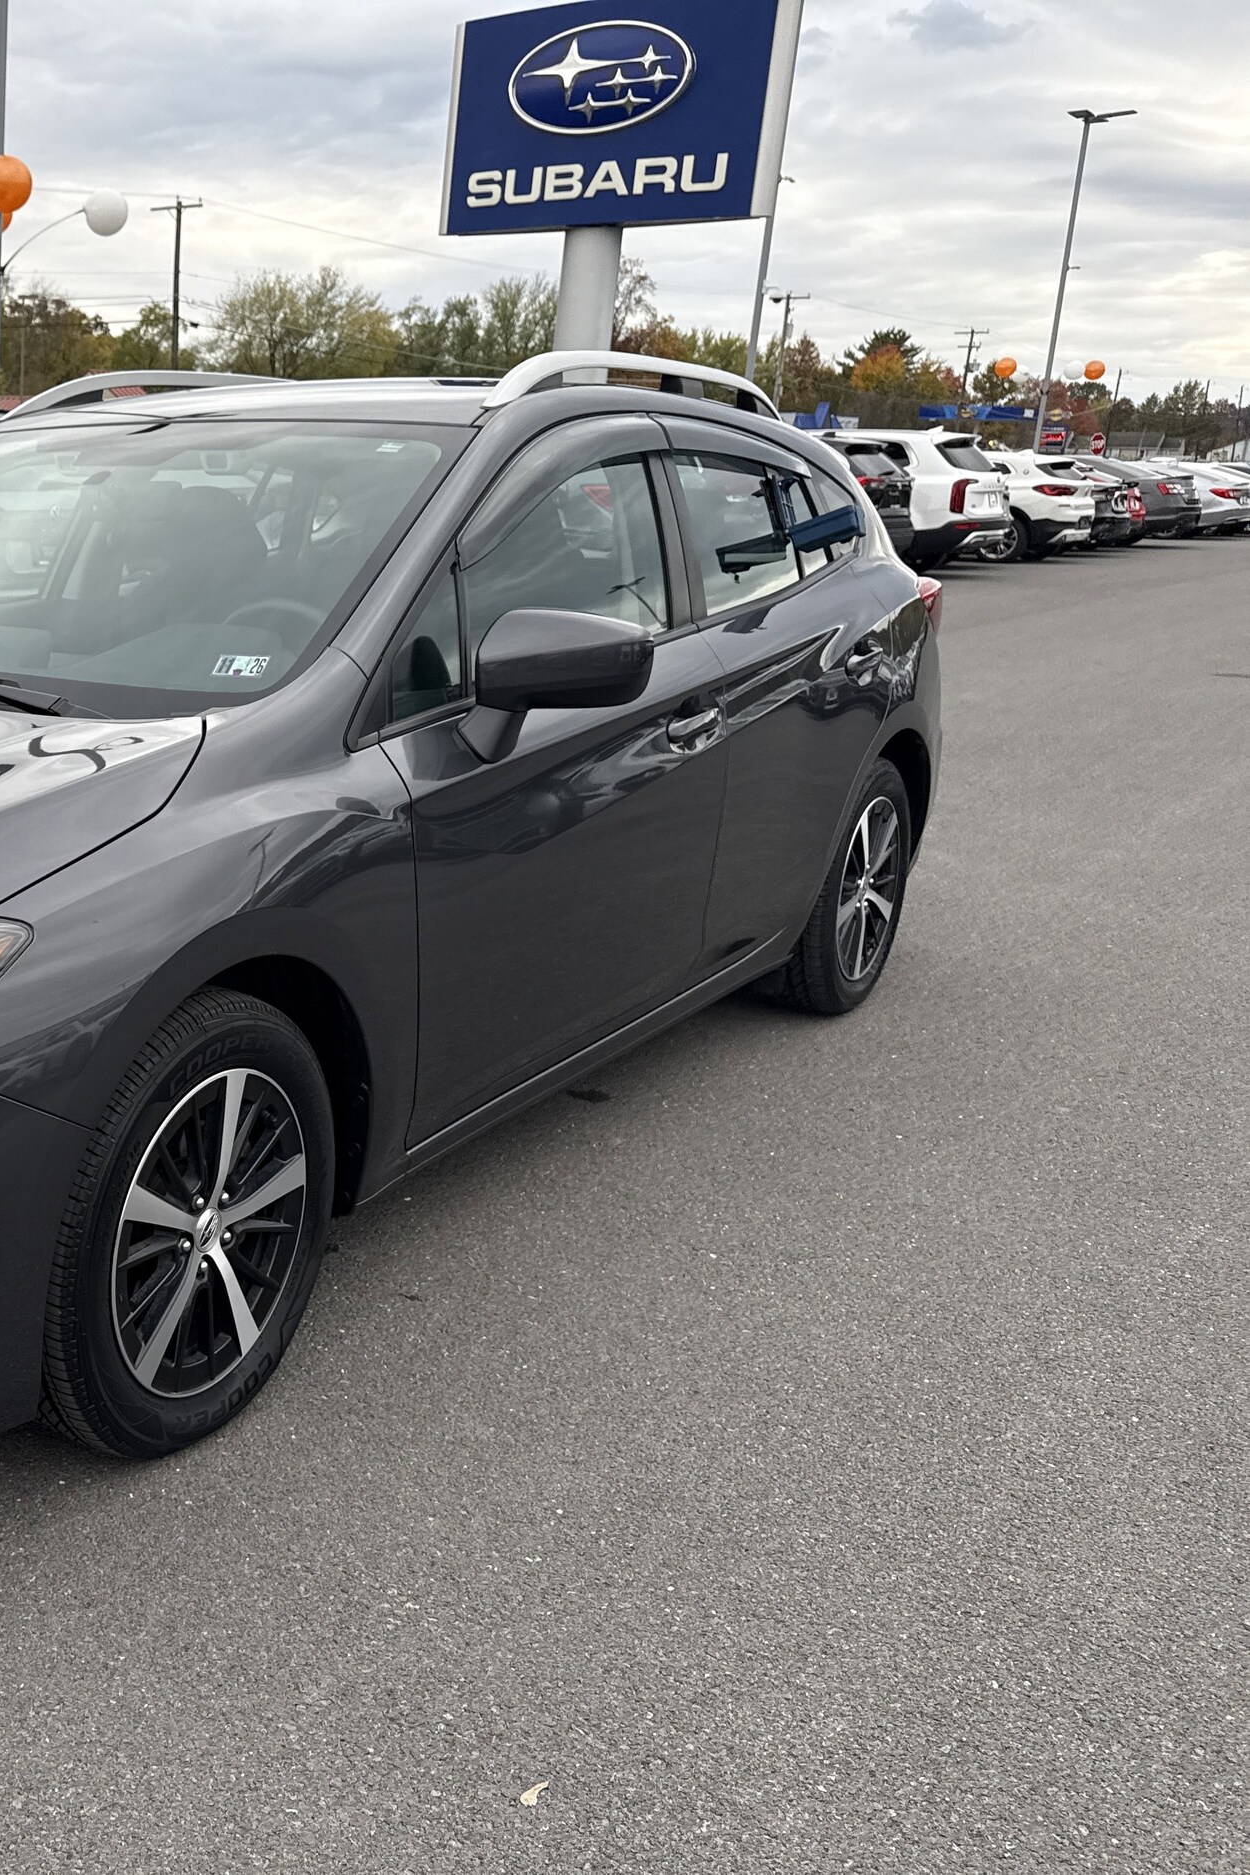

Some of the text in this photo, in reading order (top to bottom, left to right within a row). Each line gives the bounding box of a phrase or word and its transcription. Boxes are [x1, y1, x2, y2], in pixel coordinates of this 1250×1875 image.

[466, 153, 729, 208] SUBARU
[1091, 440, 1105, 450] STOP
[249, 658, 266, 673] 26
